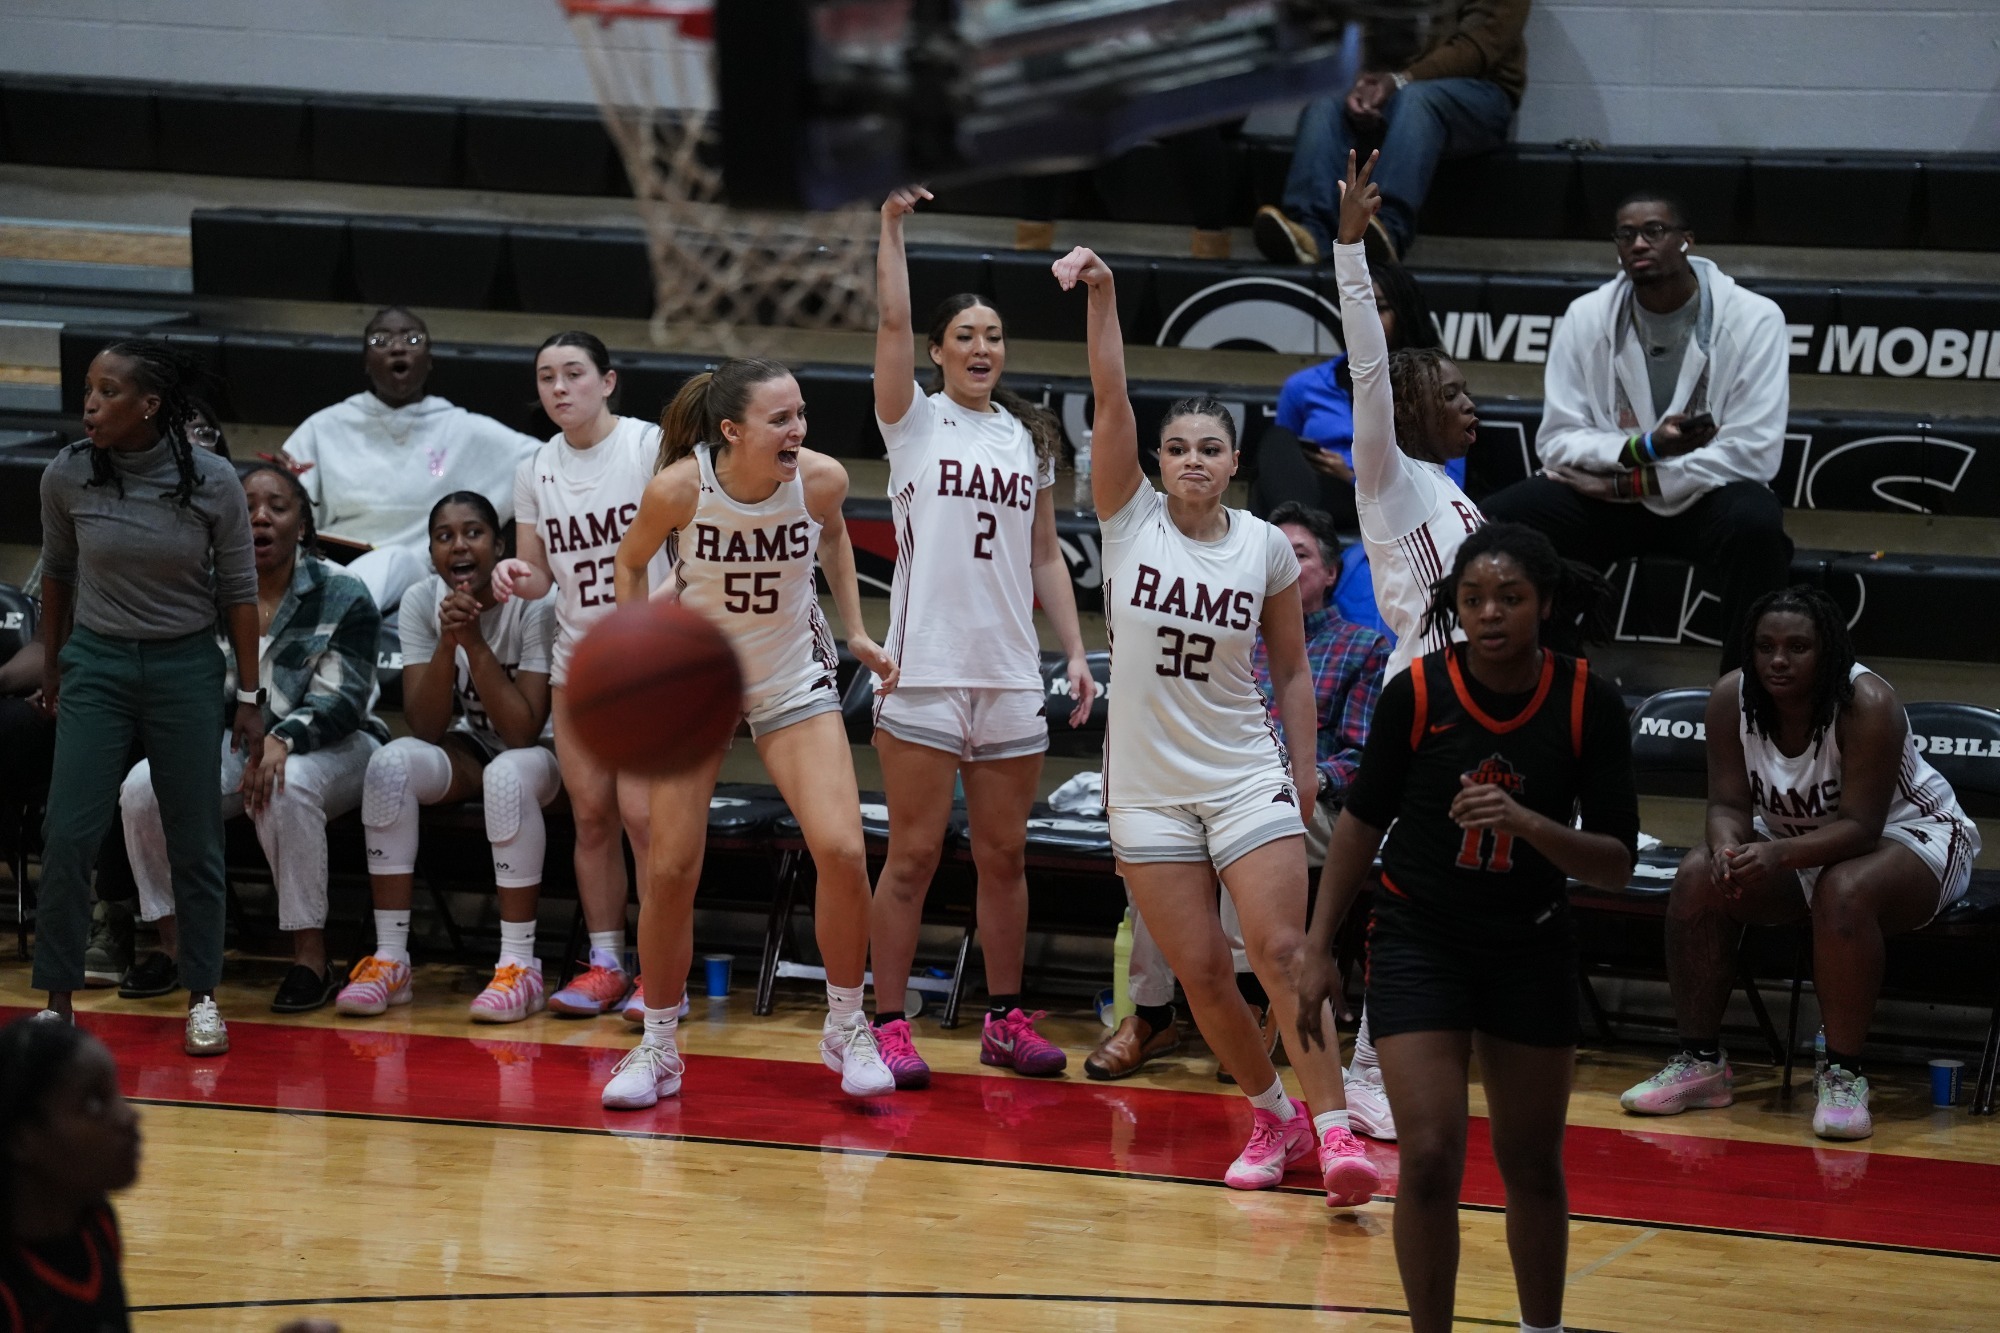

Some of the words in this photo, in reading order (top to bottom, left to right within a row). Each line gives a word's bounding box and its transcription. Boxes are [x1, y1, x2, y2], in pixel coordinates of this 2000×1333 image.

[937, 459, 1033, 511] RAMS
[545, 502, 638, 554] RAMS
[695, 520, 810, 563] RAMS
[973, 511, 997, 560] 2
[573, 556, 616, 608] 23
[724, 571, 782, 614] 55
[1130, 563, 1254, 631] RAMS
[1155, 625, 1216, 683] 32
[1911, 734, 2000, 758] OBILE
